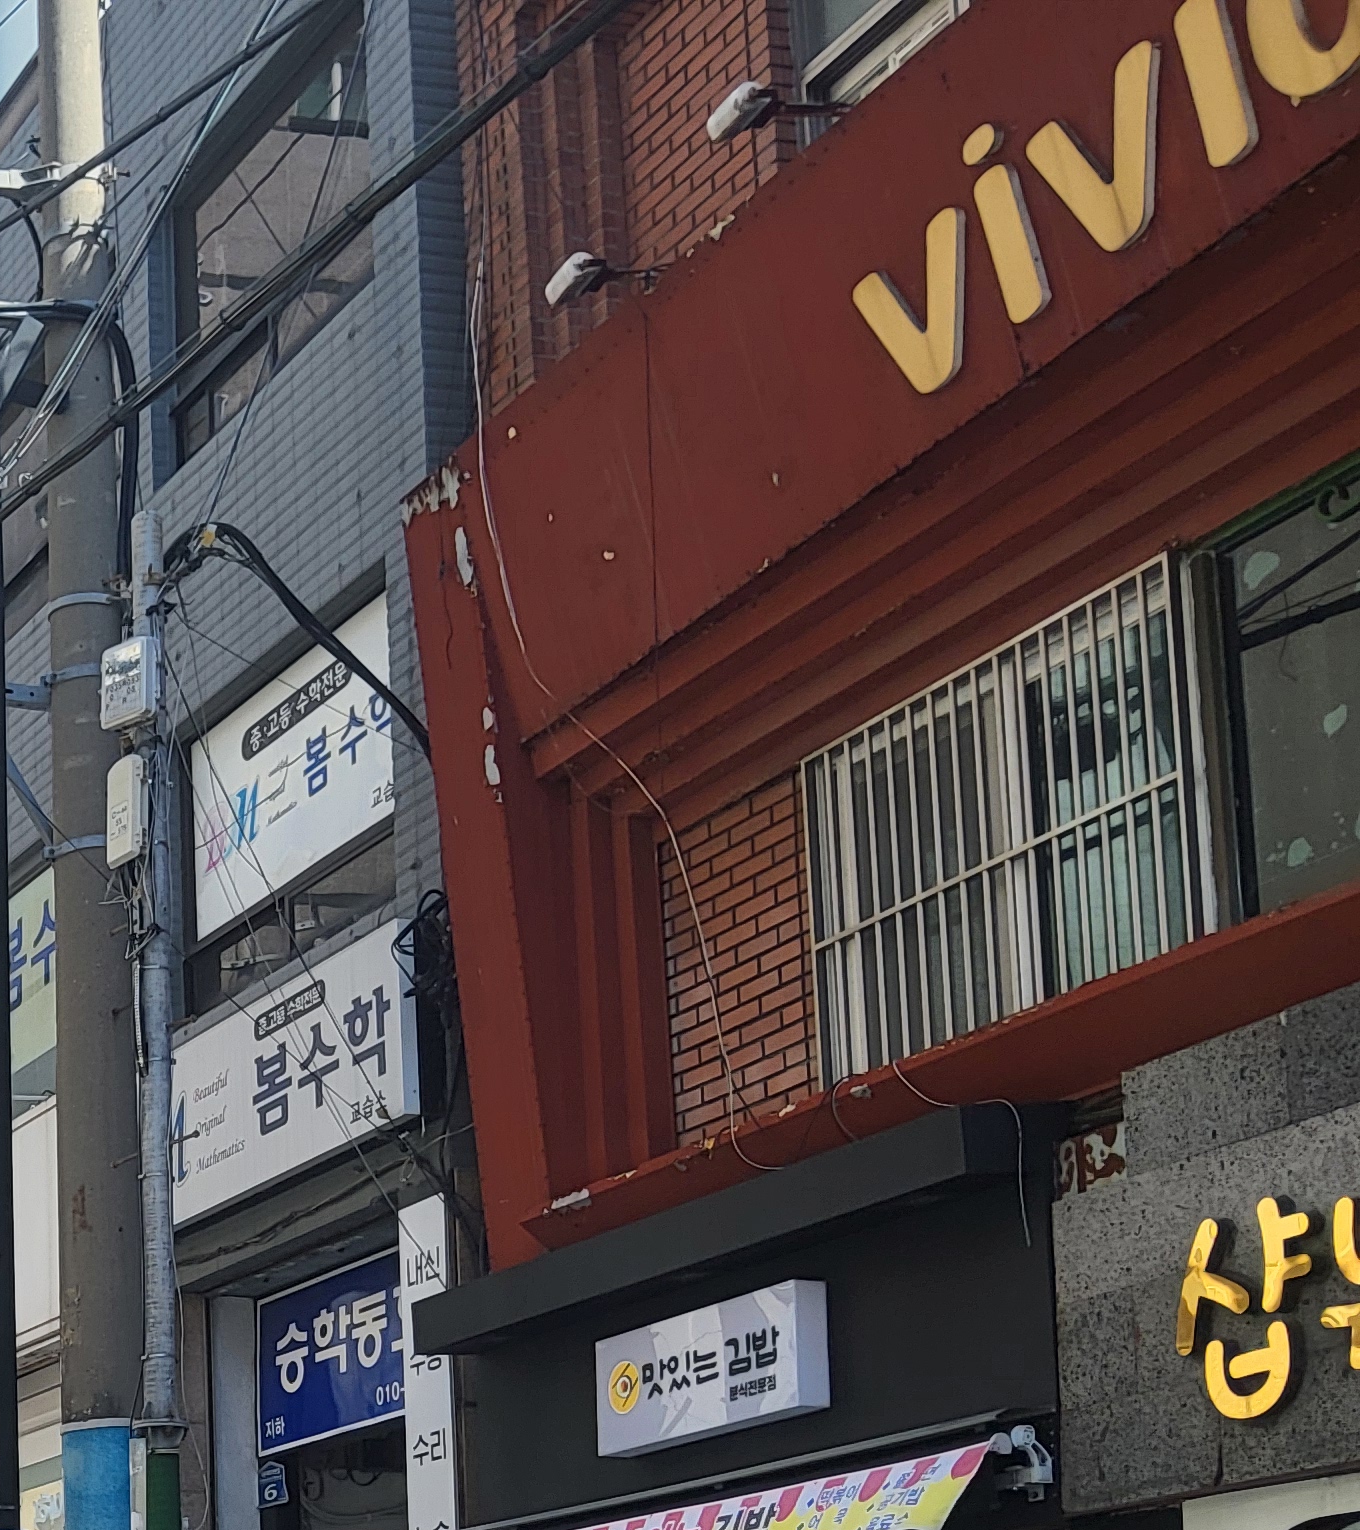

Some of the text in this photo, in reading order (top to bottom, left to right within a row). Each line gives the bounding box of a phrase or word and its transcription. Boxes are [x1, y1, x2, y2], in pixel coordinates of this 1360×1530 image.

[252, 984, 391, 1136] 봄수학
[193, 1068, 230, 1104] Beautiful
[195, 1104, 227, 1137] Original
[196, 1138, 245, 1175] Mathematics
[406, 1245, 441, 1288] 내신
[641, 1325, 780, 1400] 맛있는 김밥
[729, 1373, 777, 1402] 분식전문점
[265, 1417, 286, 1439] 지하
[413, 1428, 447, 1467] 수리
[263, 1483, 278, 1502] 6
